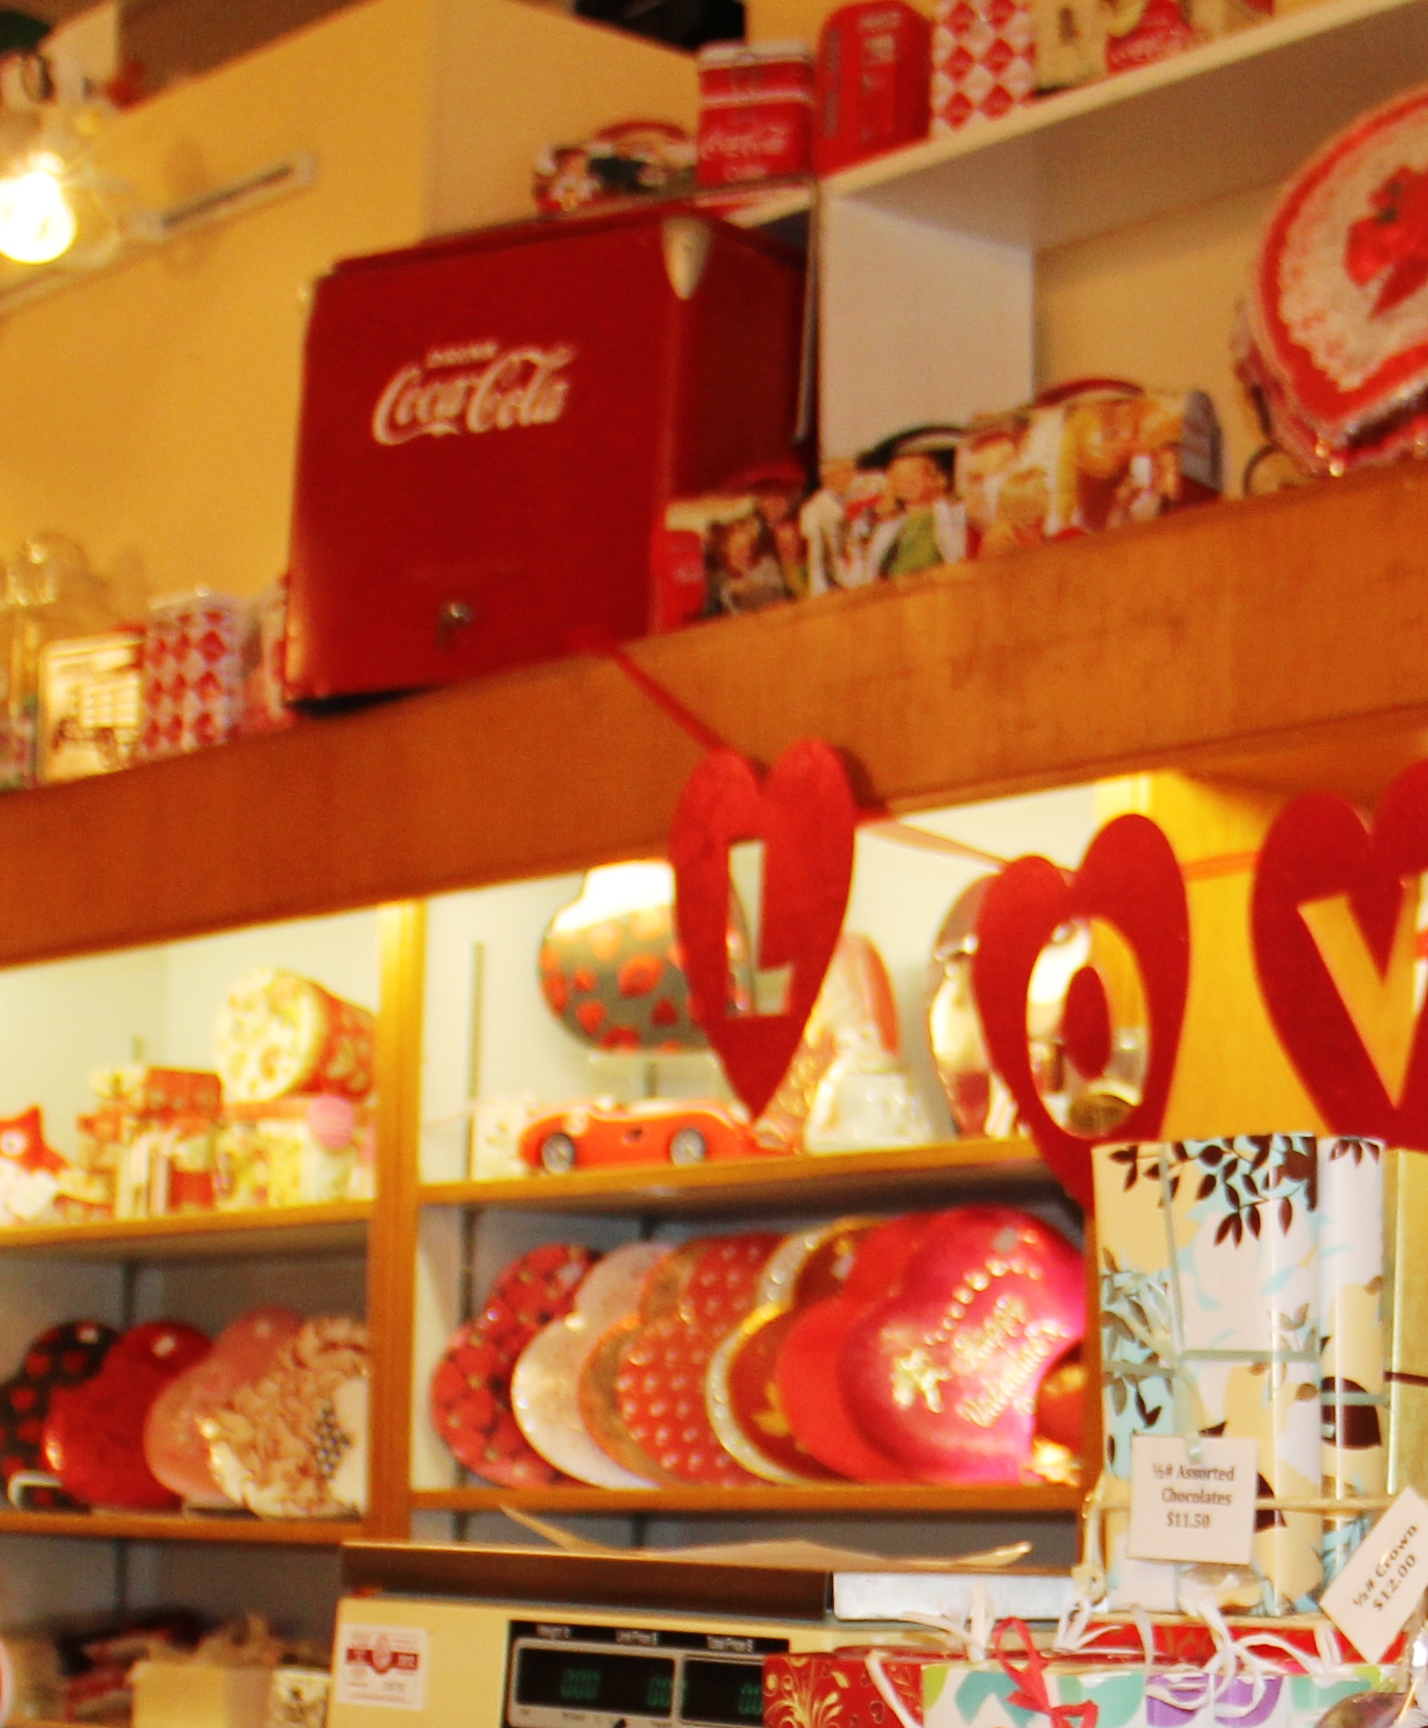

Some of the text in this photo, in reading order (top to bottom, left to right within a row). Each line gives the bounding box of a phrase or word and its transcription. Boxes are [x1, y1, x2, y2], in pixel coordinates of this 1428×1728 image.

[1162, 1487, 1232, 1505] Chocolates
[1167, 1511, 1210, 1528] $11.50
[1375, 1525, 1418, 1577] Crown
[1372, 1554, 1416, 1613] $12.00
